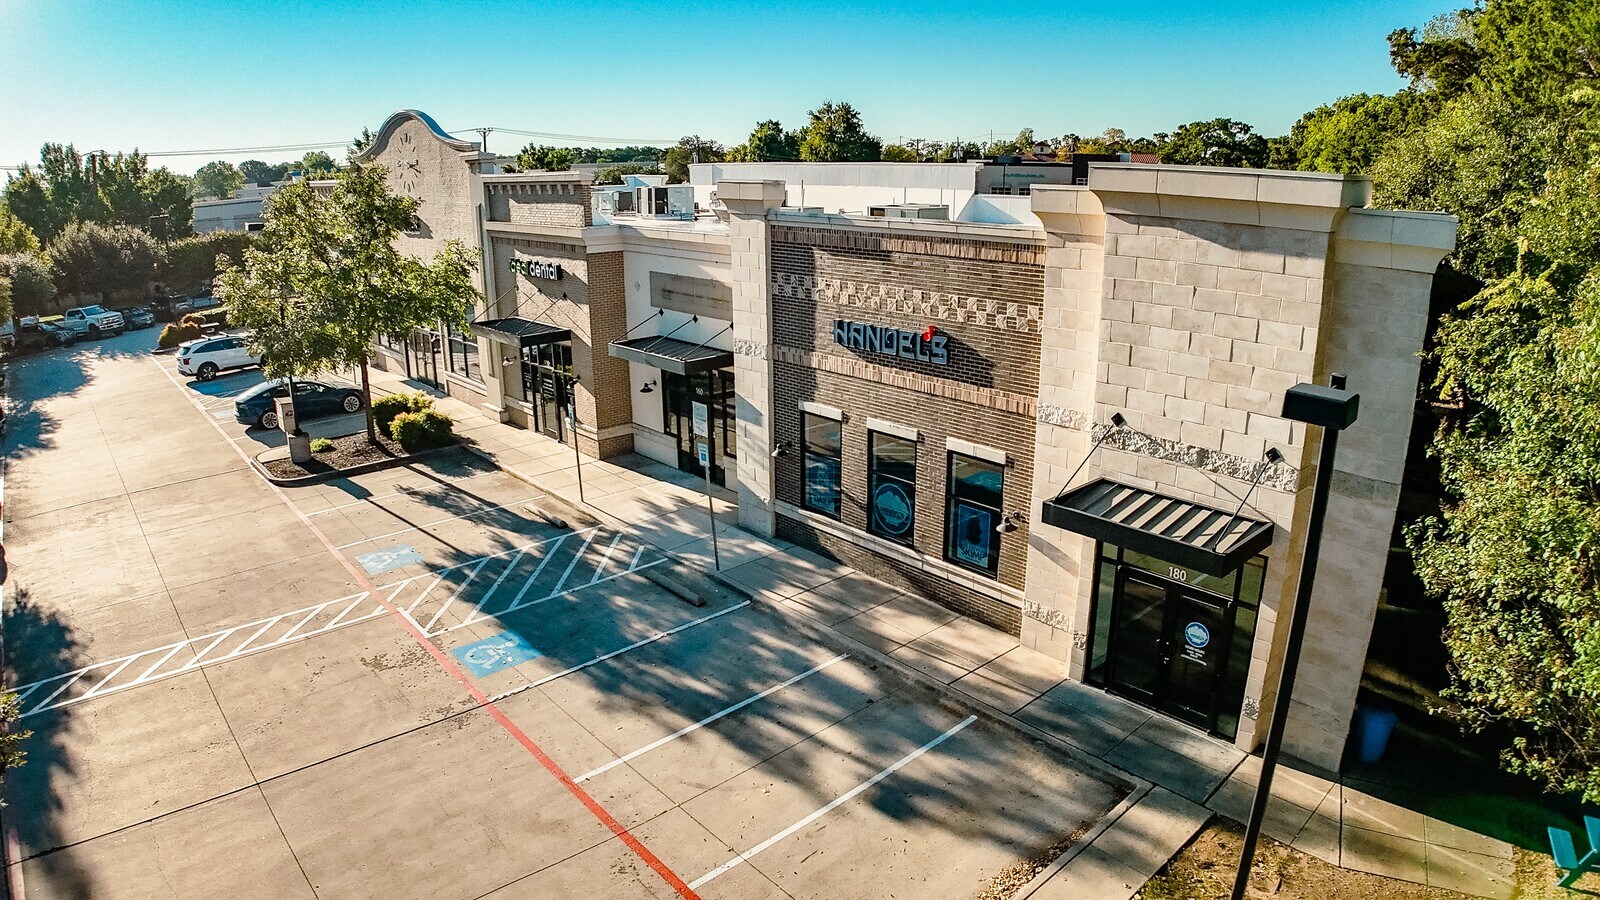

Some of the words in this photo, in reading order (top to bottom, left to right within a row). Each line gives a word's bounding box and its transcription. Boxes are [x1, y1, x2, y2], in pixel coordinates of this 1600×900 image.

[530, 261, 558, 280] dental
[833, 320, 948, 365] HANDEL'S
[1168, 566, 1187, 581] 180
